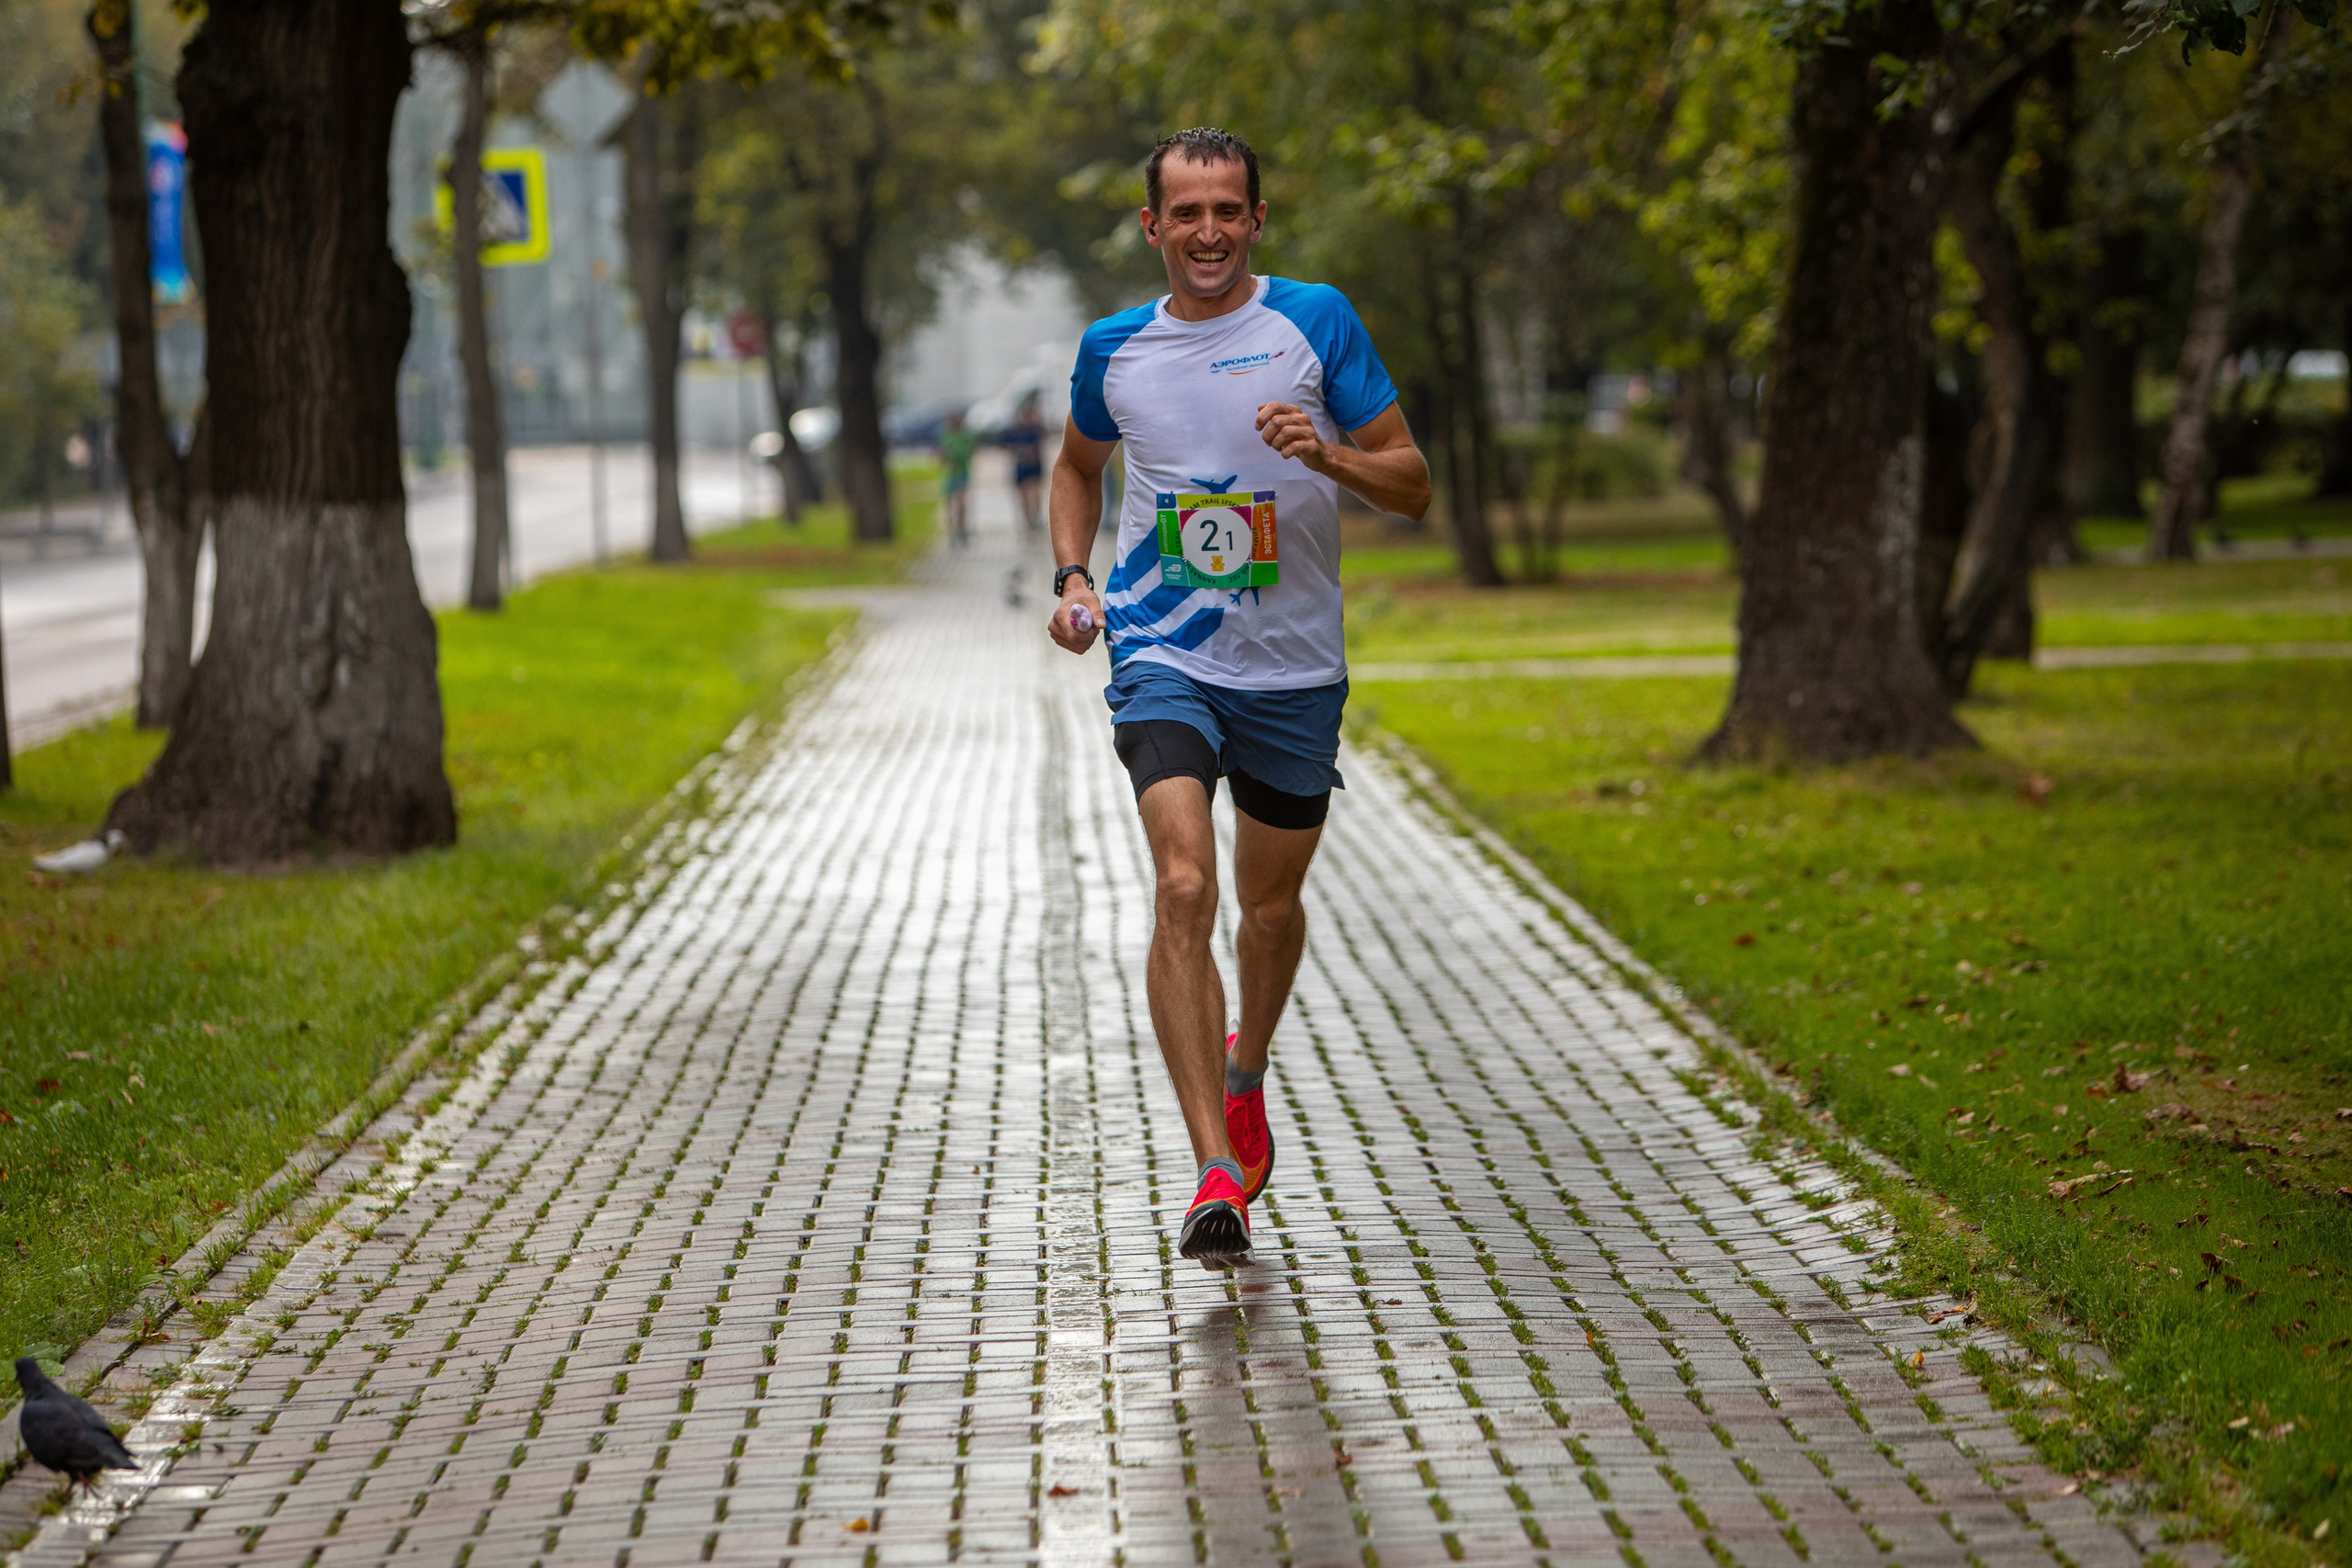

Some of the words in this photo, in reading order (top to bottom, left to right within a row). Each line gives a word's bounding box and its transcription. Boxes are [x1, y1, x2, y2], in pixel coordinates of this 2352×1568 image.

[1210, 353, 1271, 368] АЭРОФЛОТ
[1181, 502, 1200, 521] DREAM
[1201, 498, 1220, 506] TRAIL
[1221, 498, 1249, 517] LYSKOVO
[1262, 512, 1272, 555] ЭСТАФЕТА
[1190, 569, 1216, 584] KANNAS
[1227, 572, 1240, 583] ЛЕС
